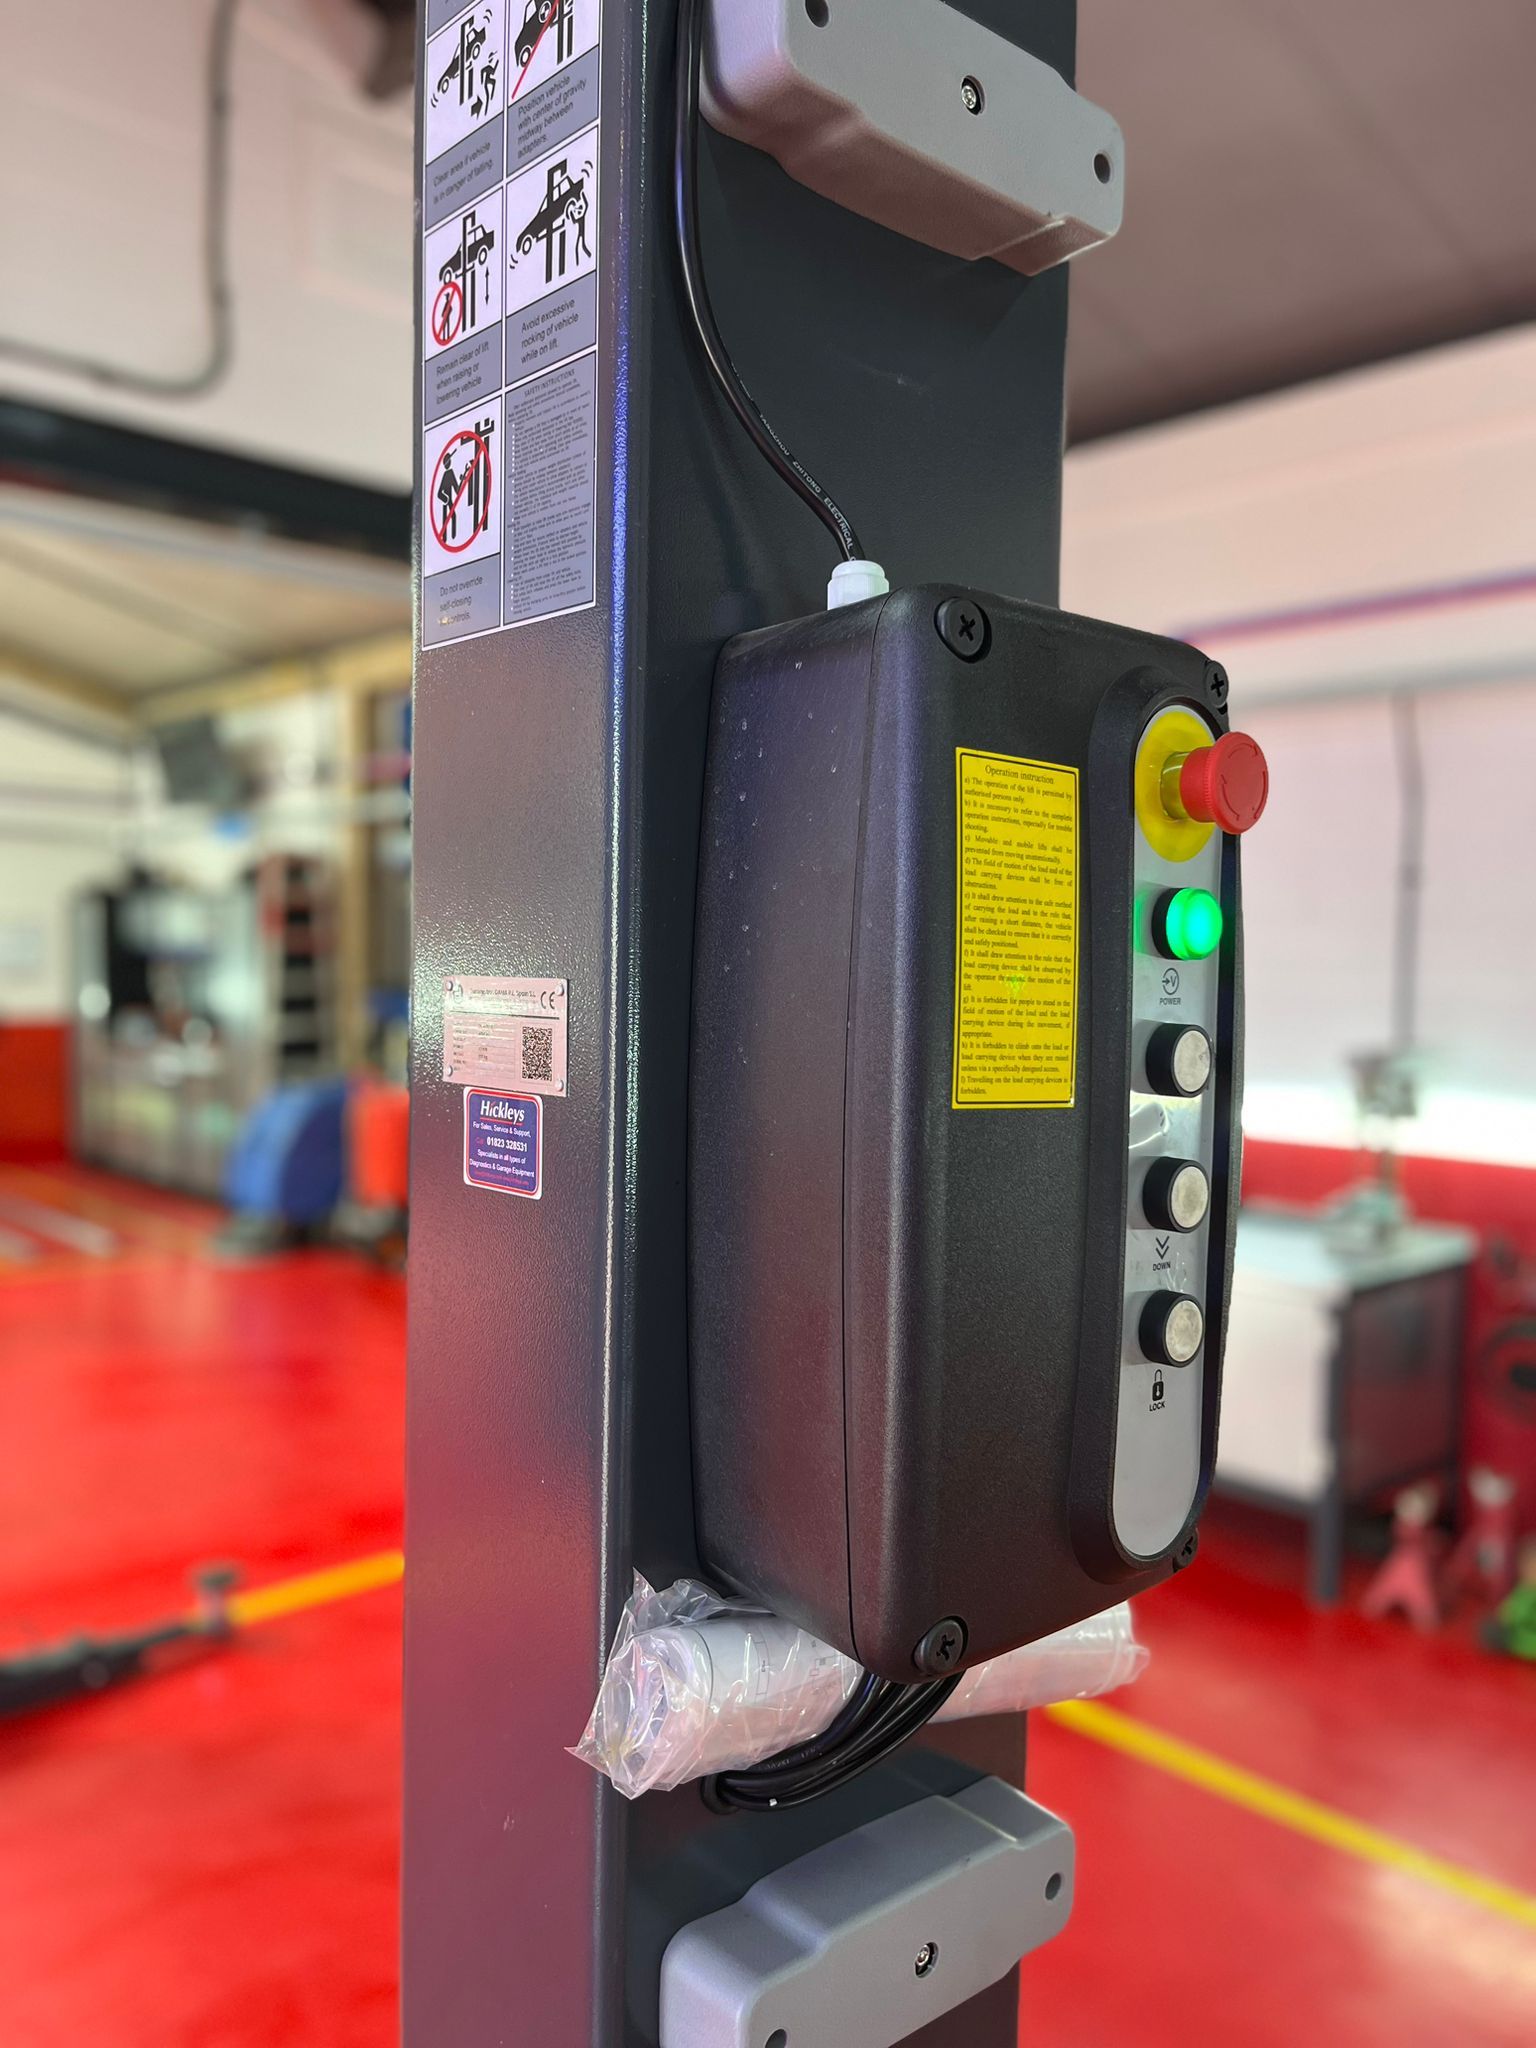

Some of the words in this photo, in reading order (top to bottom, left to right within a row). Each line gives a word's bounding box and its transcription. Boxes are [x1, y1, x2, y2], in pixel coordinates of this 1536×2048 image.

[518, 92, 544, 115] Position
[546, 76, 570, 98] vehicle
[518, 116, 532, 130] with
[532, 104, 554, 122] center
[563, 78, 587, 104] gravity
[518, 124, 542, 145] midway
[544, 102, 574, 126] between
[521, 315, 540, 332] Avoid
[541, 299, 575, 323] excessive
[521, 329, 545, 348] rocking
[554, 312, 579, 332] vehicle
[436, 358, 459, 376] Remain
[459, 349, 474, 365] clear
[521, 350, 538, 364] while
[437, 374, 452, 390] when
[452, 364, 472, 384] raising
[461, 376, 482, 394] vehicle
[524, 382, 541, 397] SAFETY
[542, 369, 575, 390] INSTRUCTIONS
[824, 498, 854, 550] ELECTRICAL
[449, 580, 458, 593] not
[458, 575, 483, 591] override
[440, 596, 472, 612] self-closing
[985, 764, 1018, 779] Operation
[1021, 770, 1054, 783] instruction
[984, 779, 1008, 791] operation
[993, 794, 1011, 802] persons
[1021, 807, 1032, 815] refer
[1017, 840, 1033, 849] mobile
[992, 848, 1003, 856] from
[1005, 850, 1024, 860] moving
[980, 870, 1002, 880] carrying
[974, 904, 994, 913] carrying
[985, 928, 1006, 936] checked
[978, 961, 998, 971] carrying
[1019, 998, 1034, 1007] people
[480, 1100, 525, 1125] Hickleys
[494, 1125, 509, 1133] Service
[486, 1136, 505, 1149] 01823
[506, 1140, 528, 1153] 328531
[477, 1149, 498, 1159] Specialists
[509, 1155, 520, 1164] types
[469, 1158, 492, 1170] Diagnostics
[496, 1163, 511, 1174] Garage
[512, 1166, 535, 1178] Equipment
[1152, 1262, 1170, 1271] DOWN
[1149, 1401, 1165, 1411] LOCK
